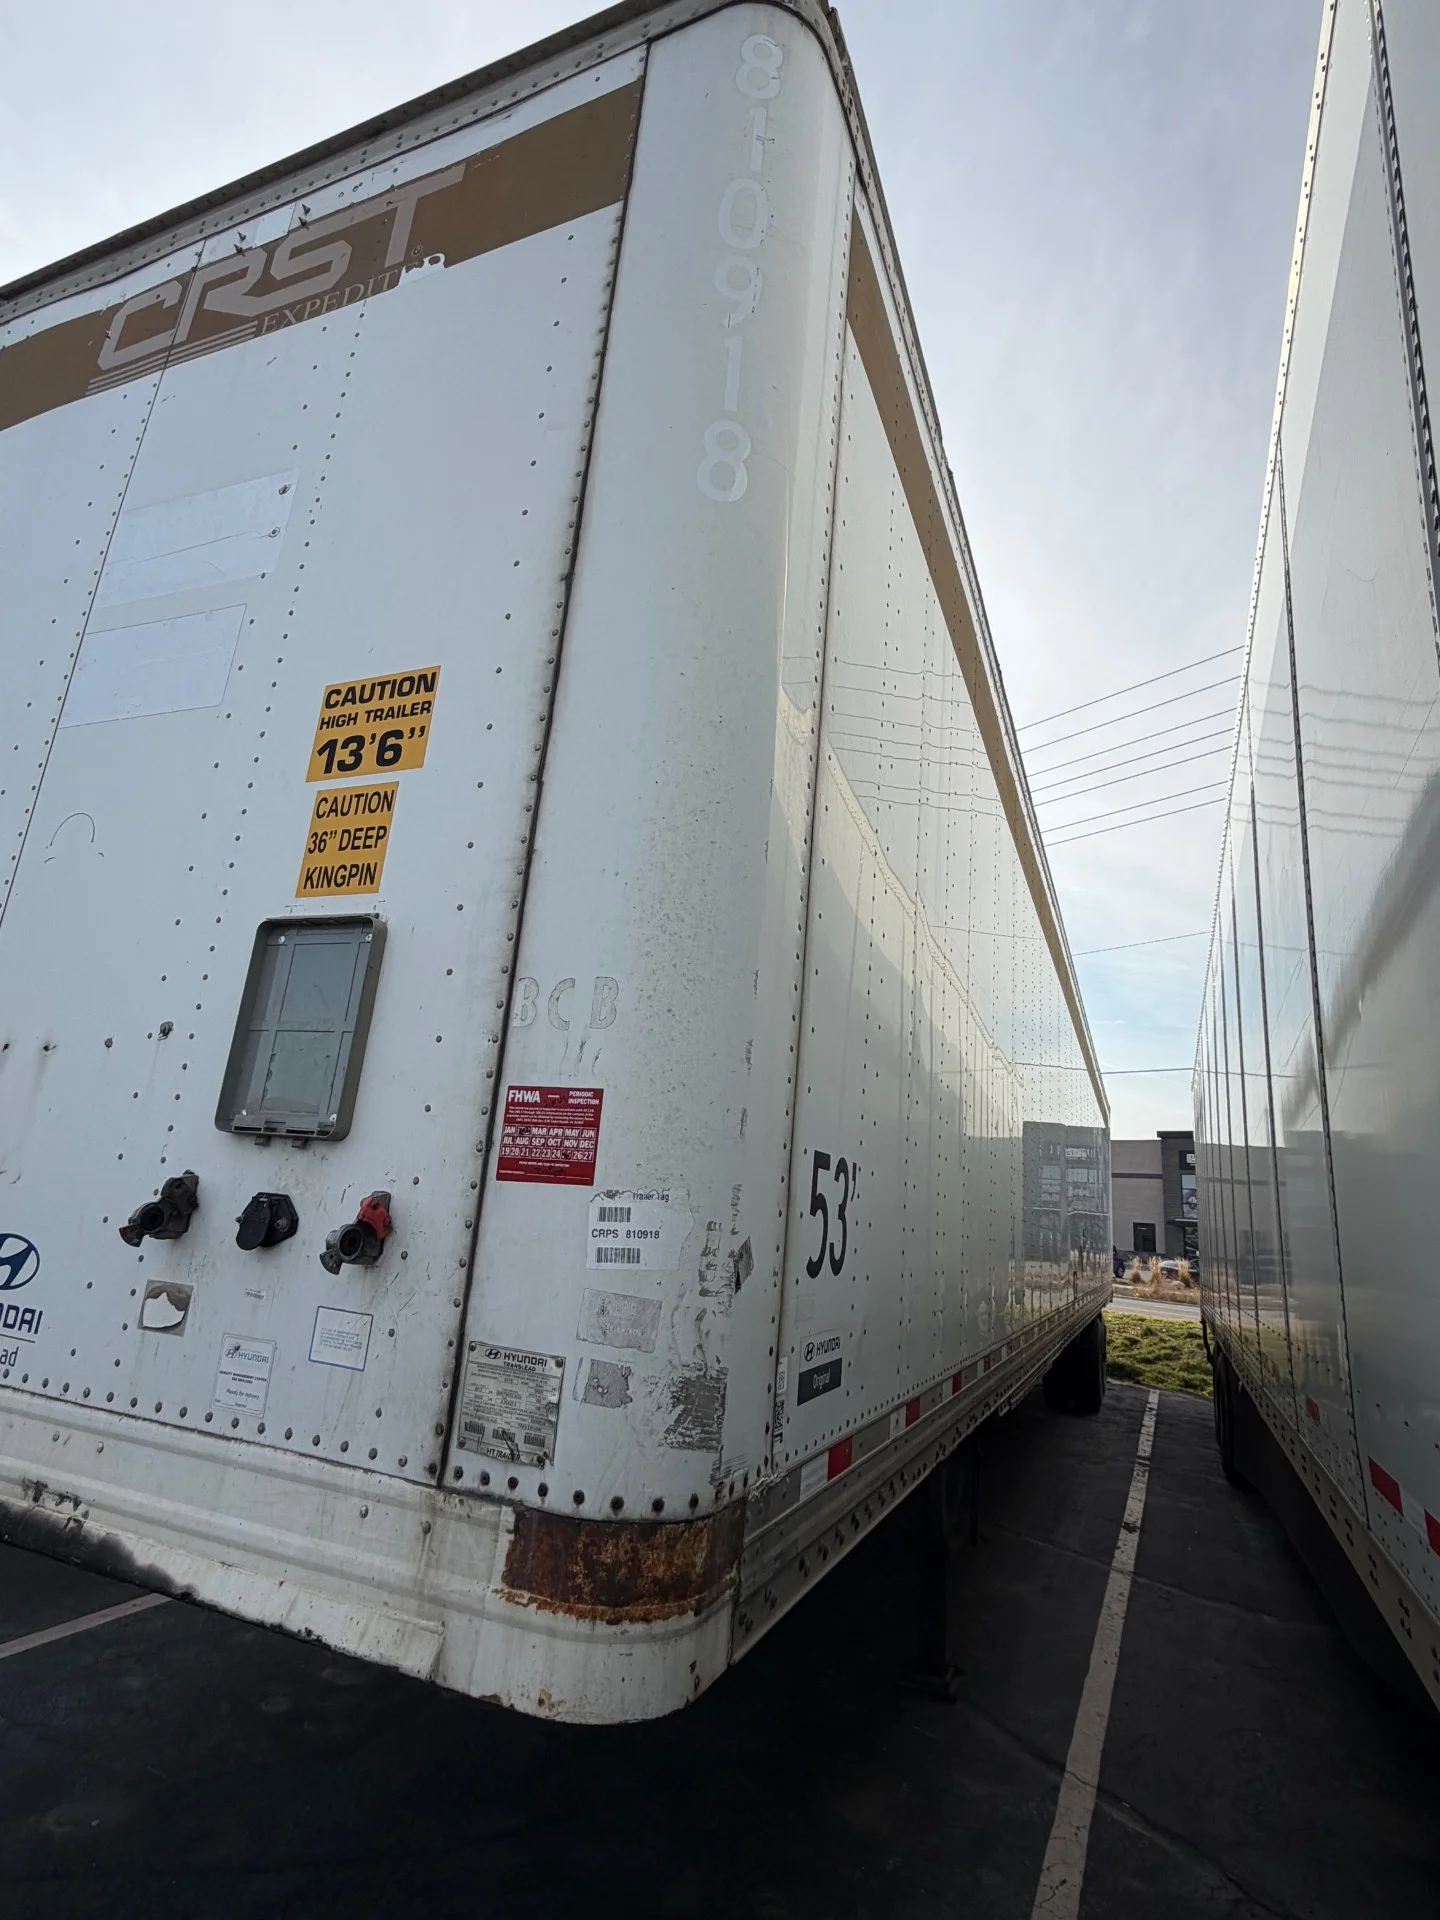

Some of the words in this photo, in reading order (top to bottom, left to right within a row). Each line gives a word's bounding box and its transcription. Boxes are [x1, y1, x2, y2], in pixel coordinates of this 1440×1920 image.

[98, 162, 466, 371] CRST
[697, 34, 784, 502] 810918
[324, 671, 437, 709] CAUTION
[319, 712, 359, 730] HIGH
[365, 700, 432, 724] TRAILER
[315, 789, 395, 819] CAUTION
[338, 825, 388, 851] DEEP
[303, 862, 378, 889] KINGPIN
[508, 1089, 541, 1103] FHWA
[504, 1125, 516, 1134] JAN
[531, 1127, 548, 1136] MAR
[549, 1127, 563, 1137] APR
[564, 1128, 580, 1137] MAY
[581, 1129, 595, 1138] JUN
[502, 1136, 514, 1145] JUL
[515, 1137, 529, 1146] AUG
[531, 1137, 546, 1147] SEP
[547, 1138, 561, 1147] OCT
[563, 1139, 578, 1148] NOV
[579, 1139, 595, 1149] DEC
[501, 1147, 509, 1156] 19
[510, 1147, 519, 1156] 20
[520, 1148, 529, 1157] 21
[531, 1149, 541, 1158] 22
[541, 1149, 551, 1158] 23
[551, 1149, 561, 1158] 24
[573, 1151, 582, 1160] 26
[583, 1151, 593, 1160] 27
[591, 1228, 619, 1238] CRPS
[625, 1229, 660, 1240] 810918
[815, 1337, 841, 1357] HYUNDAI
[238, 1352, 269, 1364] HYUNDAI
[503, 1361, 537, 1372] TRANSLEAD
[504, 1352, 547, 1367] HYUNDAI
[813, 1368, 831, 1390] Original
